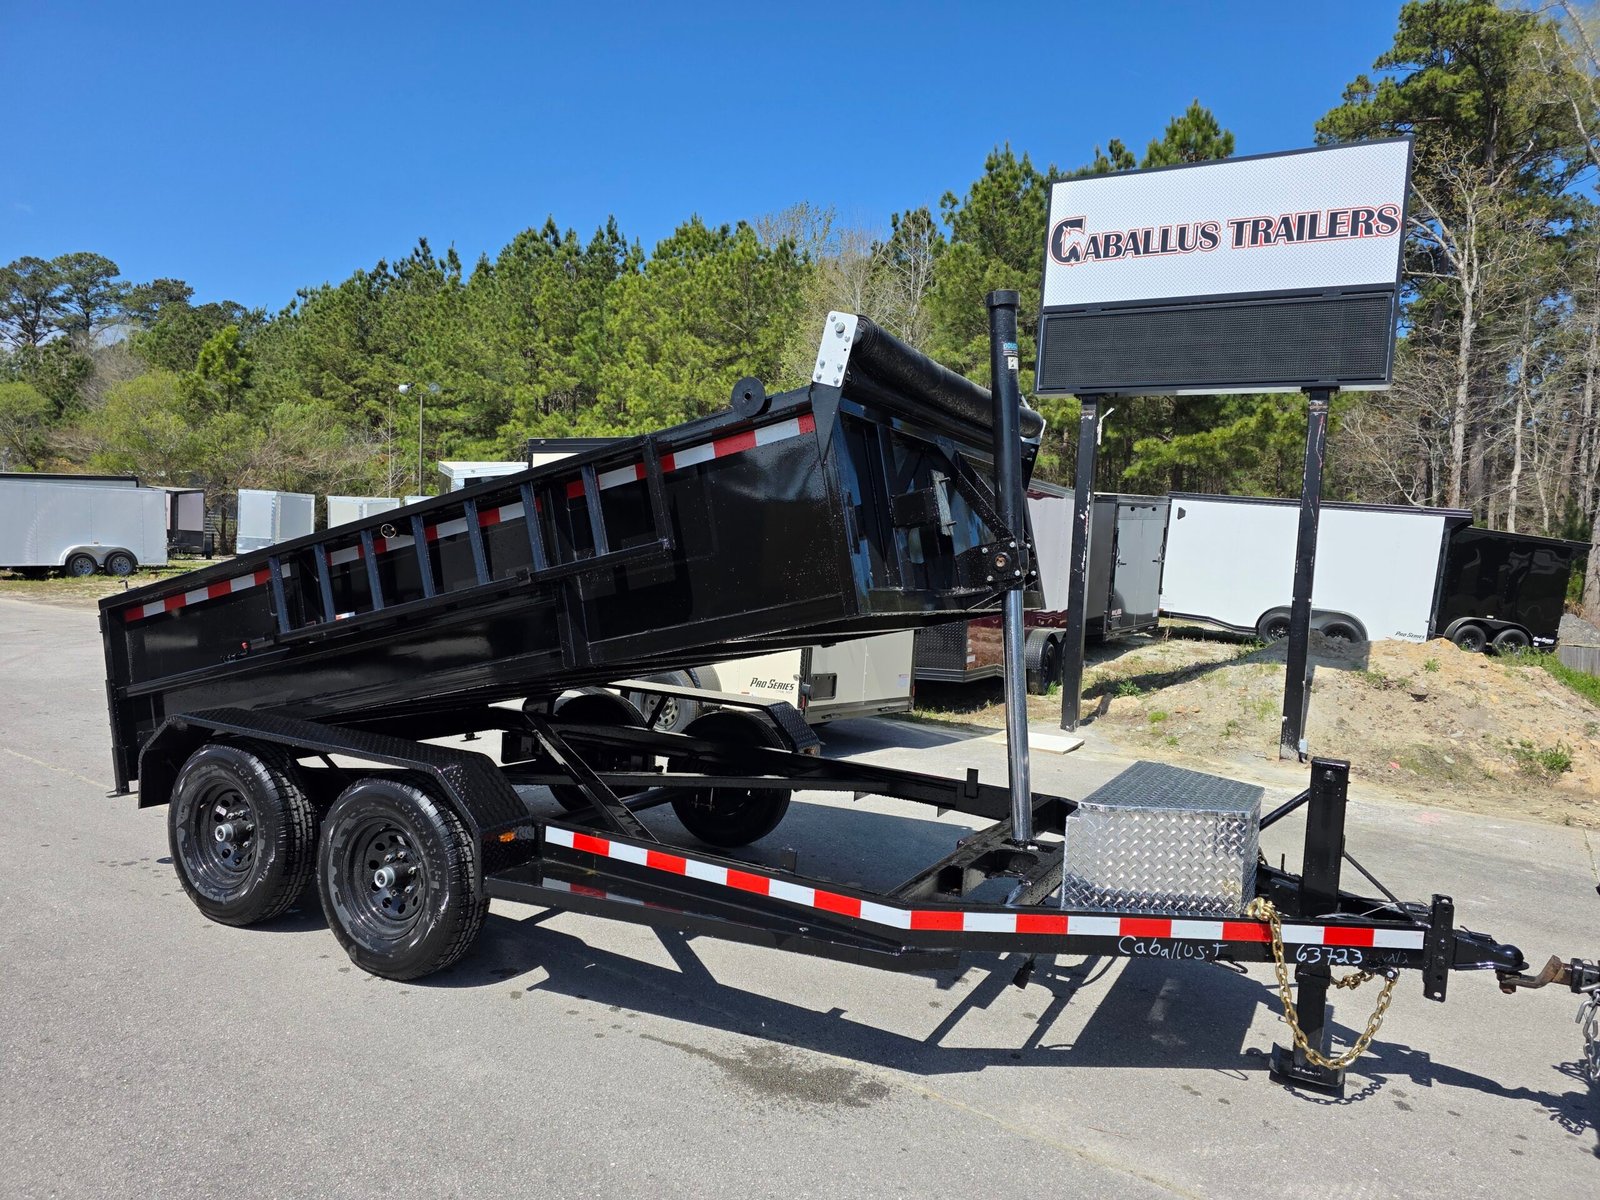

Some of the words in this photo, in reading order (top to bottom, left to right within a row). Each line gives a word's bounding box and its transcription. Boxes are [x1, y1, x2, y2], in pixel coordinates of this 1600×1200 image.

[1050, 216, 1221, 266] CABALLUS
[1228, 205, 1401, 249] TRAILERS
[750, 677, 767, 688] PRO
[767, 679, 795, 691] SERIES
[1296, 944, 1363, 965] 63723
